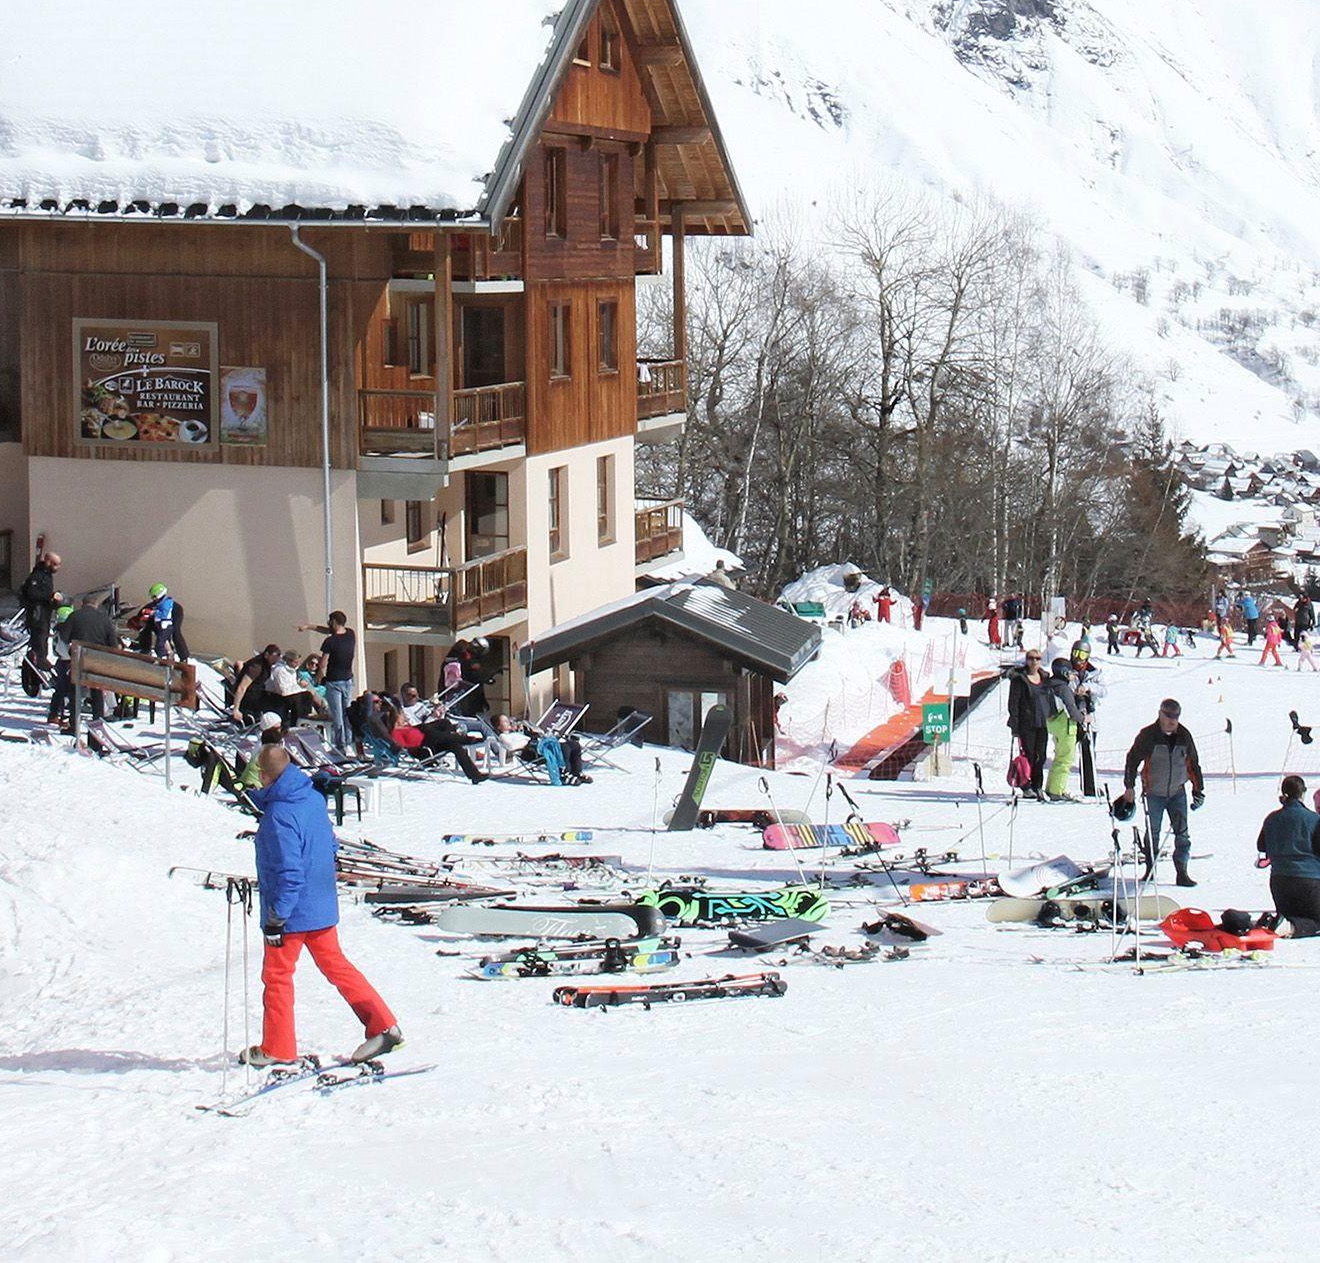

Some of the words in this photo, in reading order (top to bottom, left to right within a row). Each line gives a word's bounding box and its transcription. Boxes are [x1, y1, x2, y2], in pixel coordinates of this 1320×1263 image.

[124, 348, 165, 366] pistes
[140, 392, 200, 401] RESTAURANT
[136, 400, 154, 408] BAR
[162, 401, 204, 410] PIZZERIA
[925, 725, 948, 734] STOP
